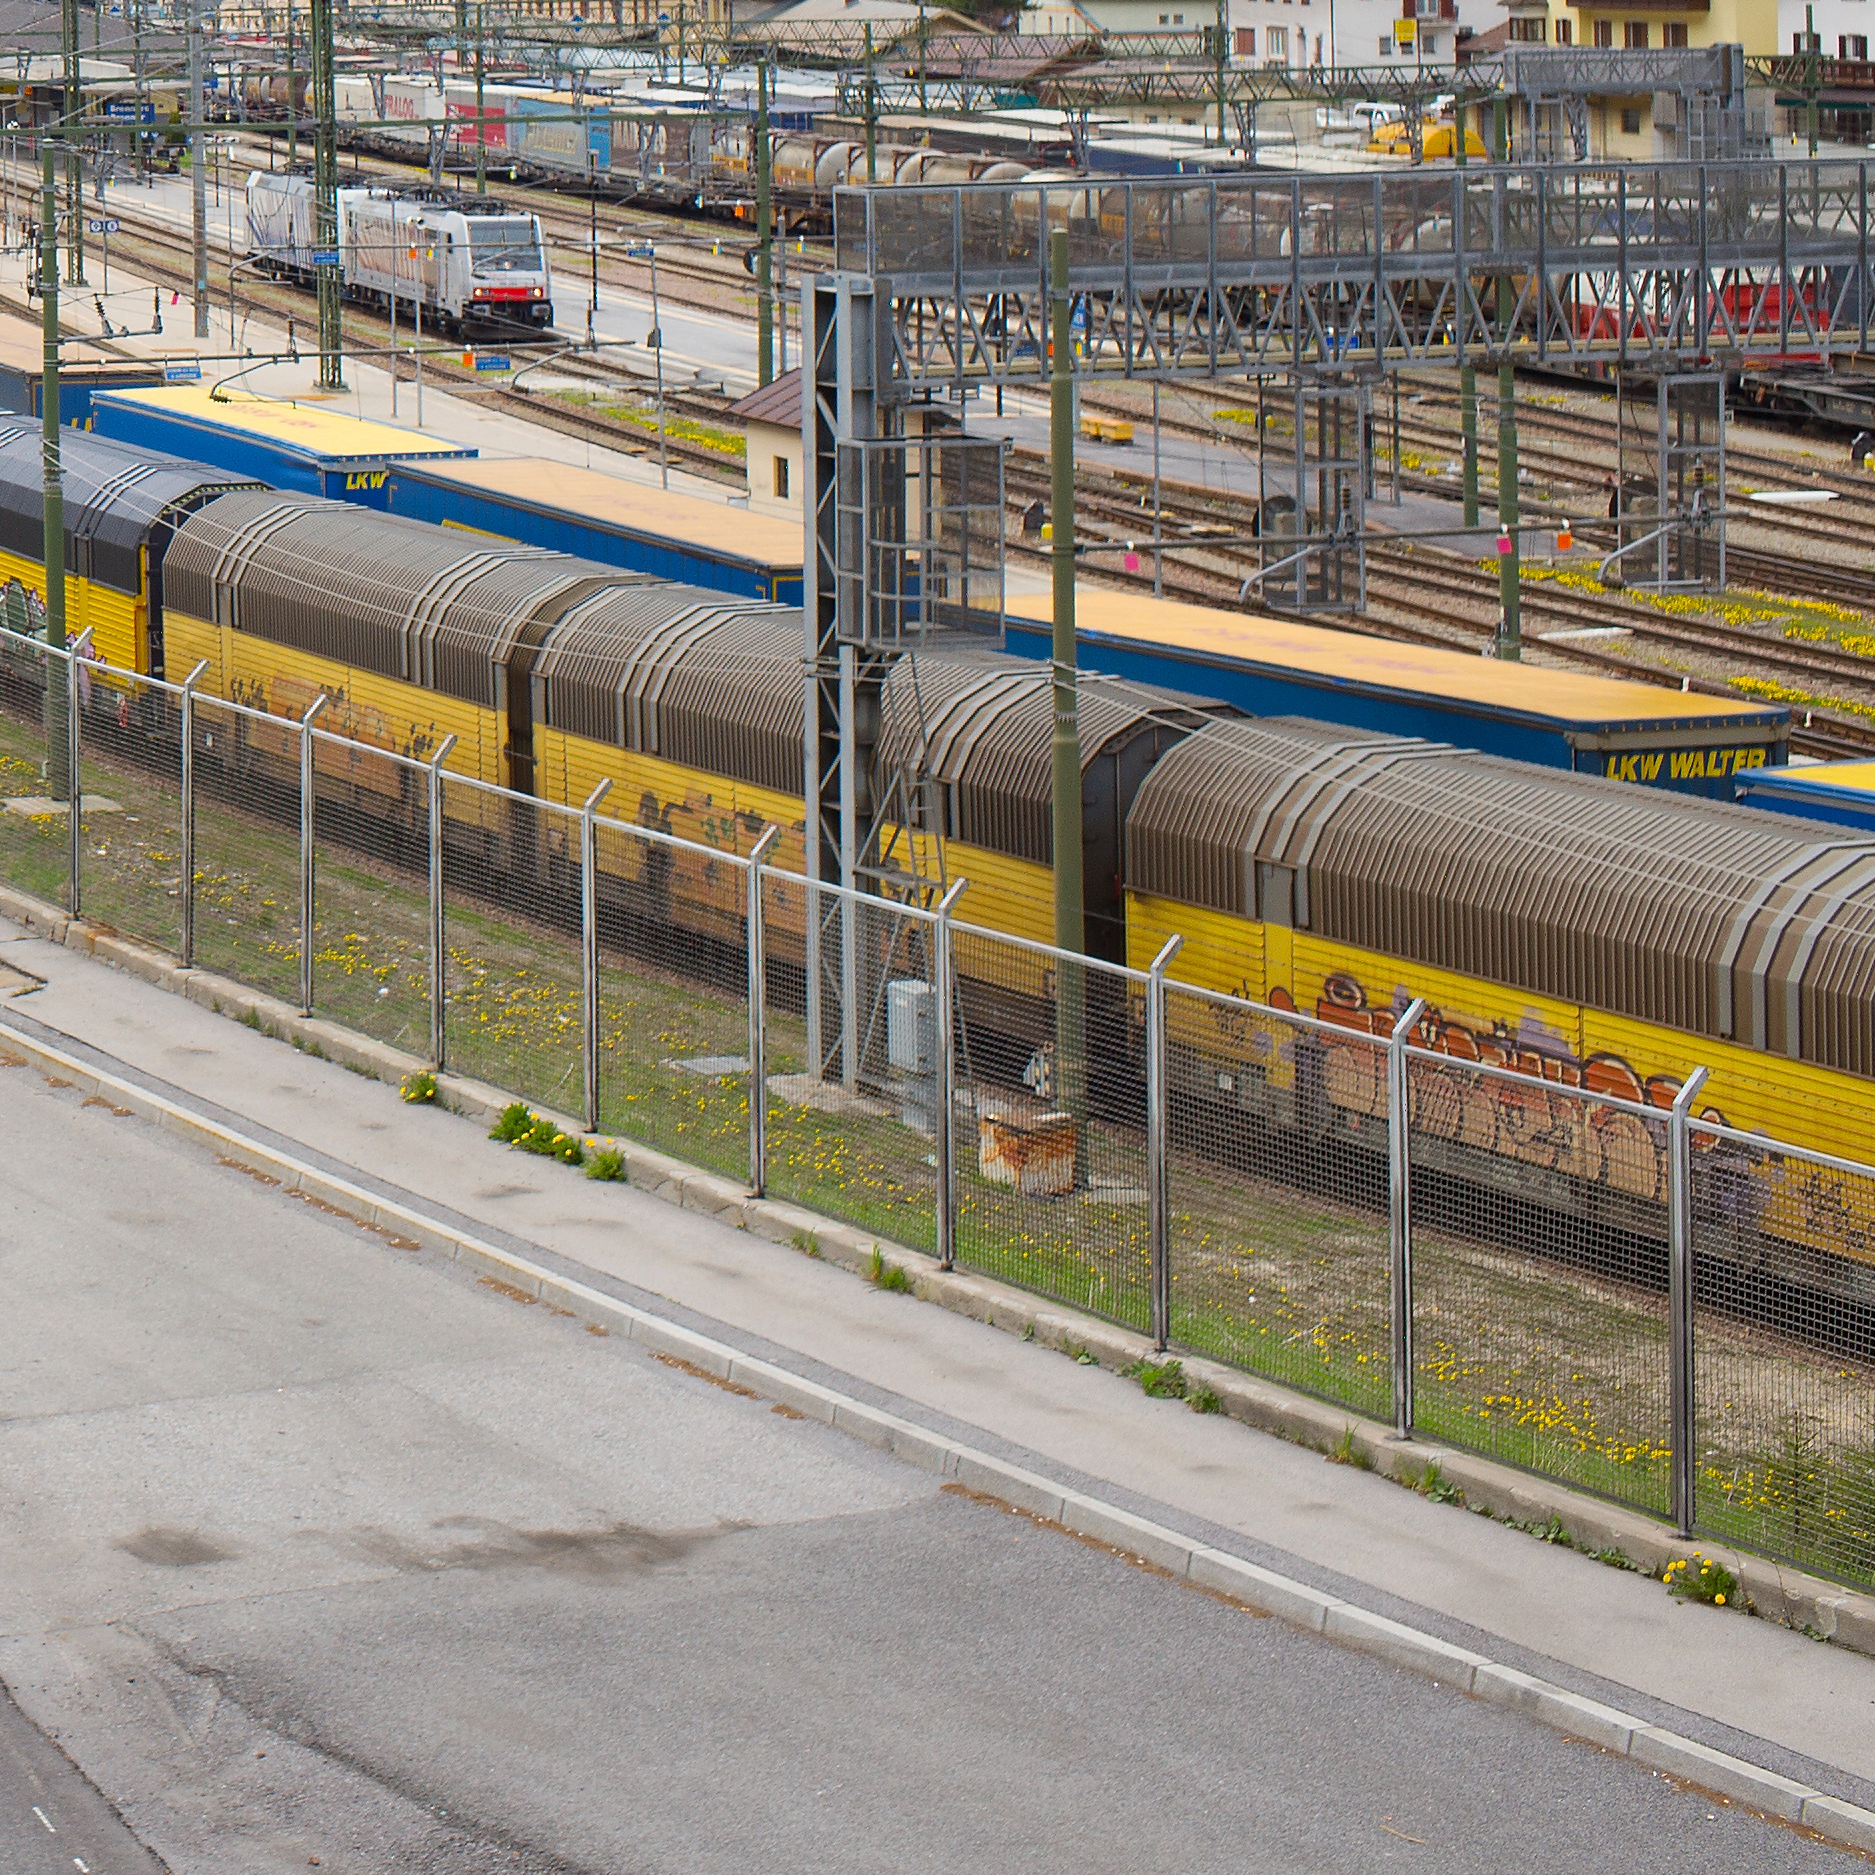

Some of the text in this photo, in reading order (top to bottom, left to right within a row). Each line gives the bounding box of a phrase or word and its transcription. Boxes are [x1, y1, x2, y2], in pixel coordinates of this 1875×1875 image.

[346, 473, 387, 490] LKW
[1606, 748, 1766, 782] LKW WALTER
